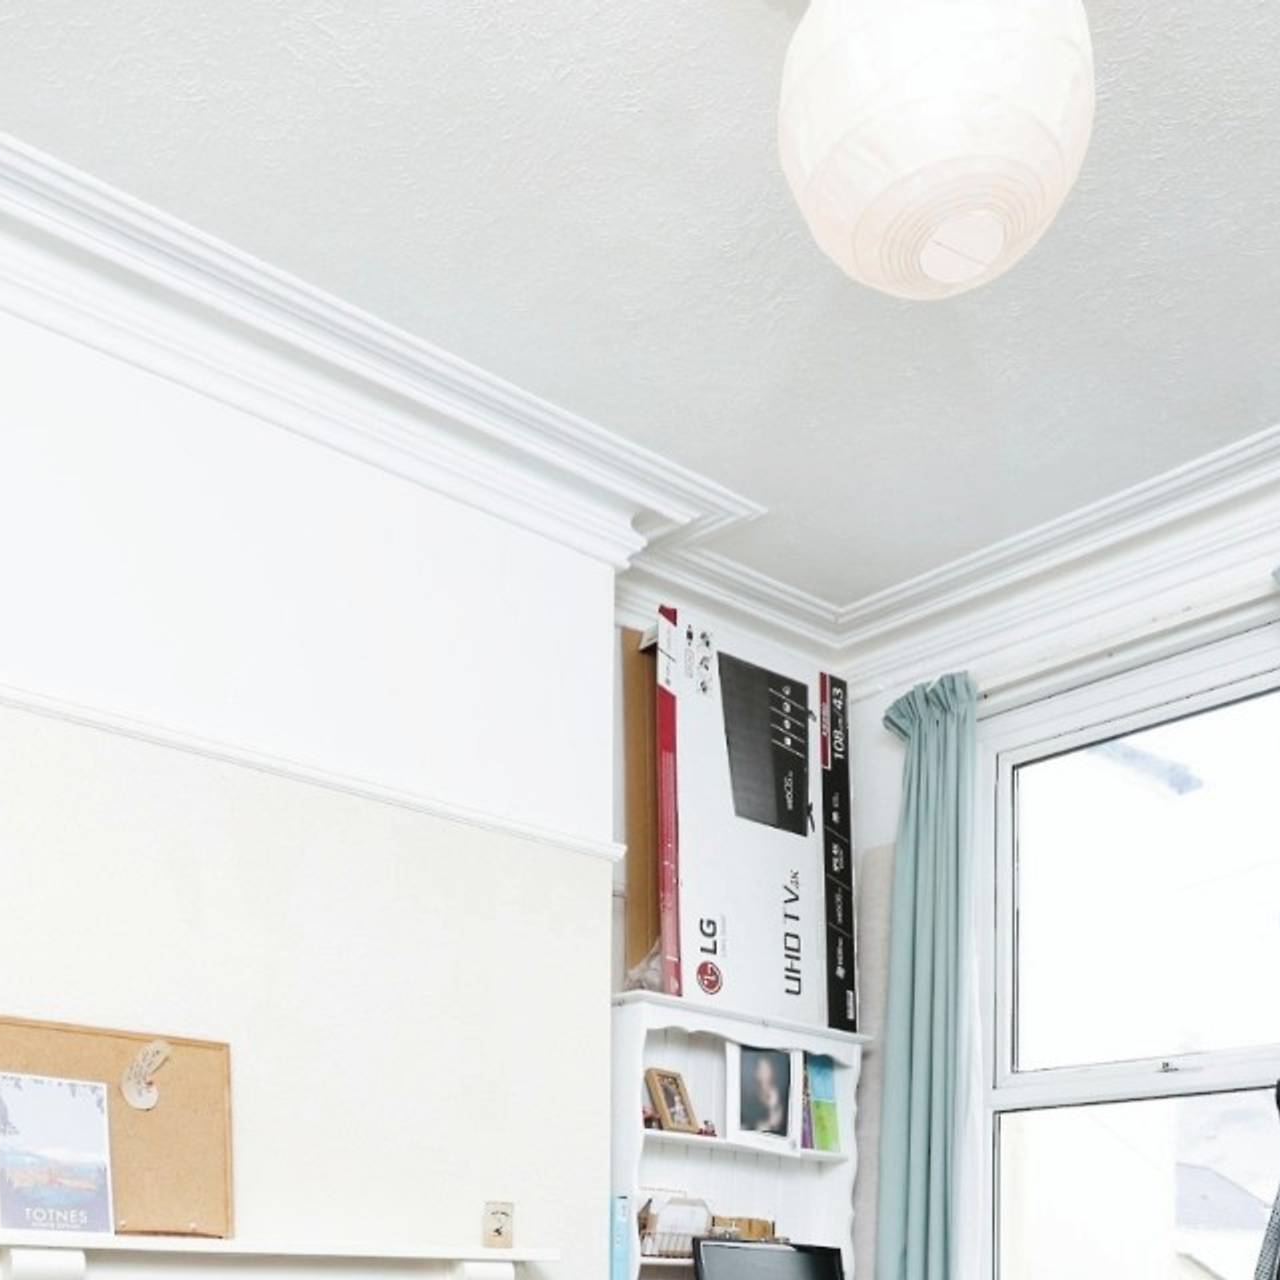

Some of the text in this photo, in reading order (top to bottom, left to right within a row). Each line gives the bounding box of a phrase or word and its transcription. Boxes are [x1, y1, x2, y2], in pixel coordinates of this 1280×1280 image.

[699, 918, 717, 955] LG
[783, 931, 802, 996] UHD
[23, 1207, 88, 1225] TOTNES
